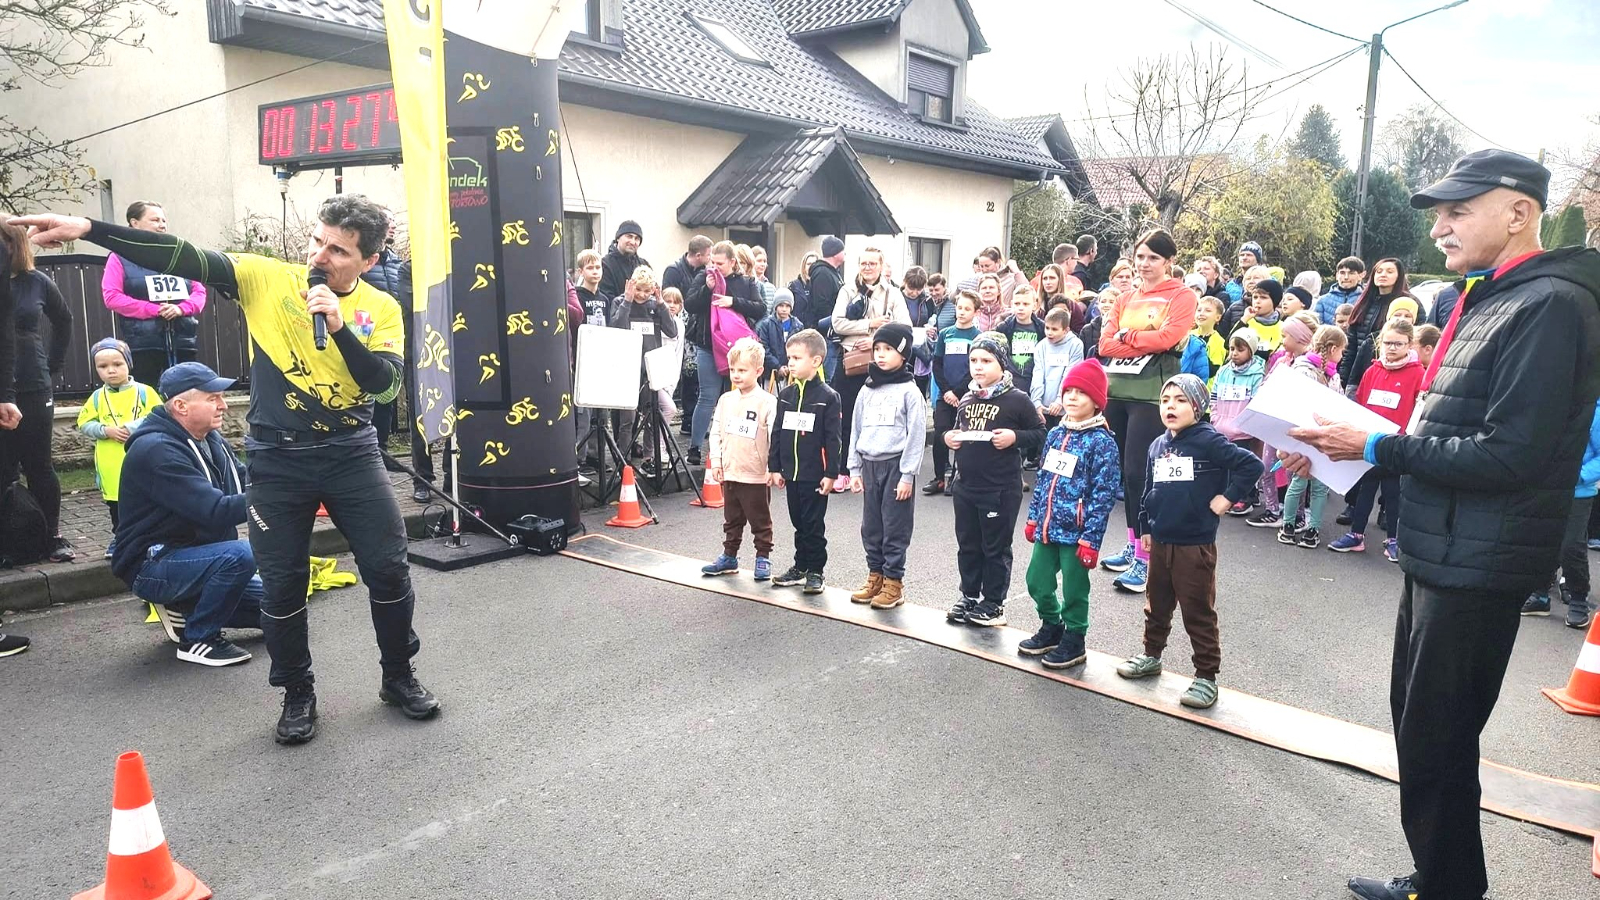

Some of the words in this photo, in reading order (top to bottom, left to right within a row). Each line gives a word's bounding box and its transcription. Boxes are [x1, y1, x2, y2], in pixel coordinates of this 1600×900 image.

[986, 201, 995, 212] 22
[152, 276, 181, 293] 512
[1382, 397, 1392, 405] 50
[965, 403, 1000, 421] SUPER
[797, 419, 807, 428] 78
[968, 417, 987, 431] SYN
[738, 425, 749, 434] 84
[1055, 460, 1067, 471] 27
[1168, 466, 1183, 478] 26
